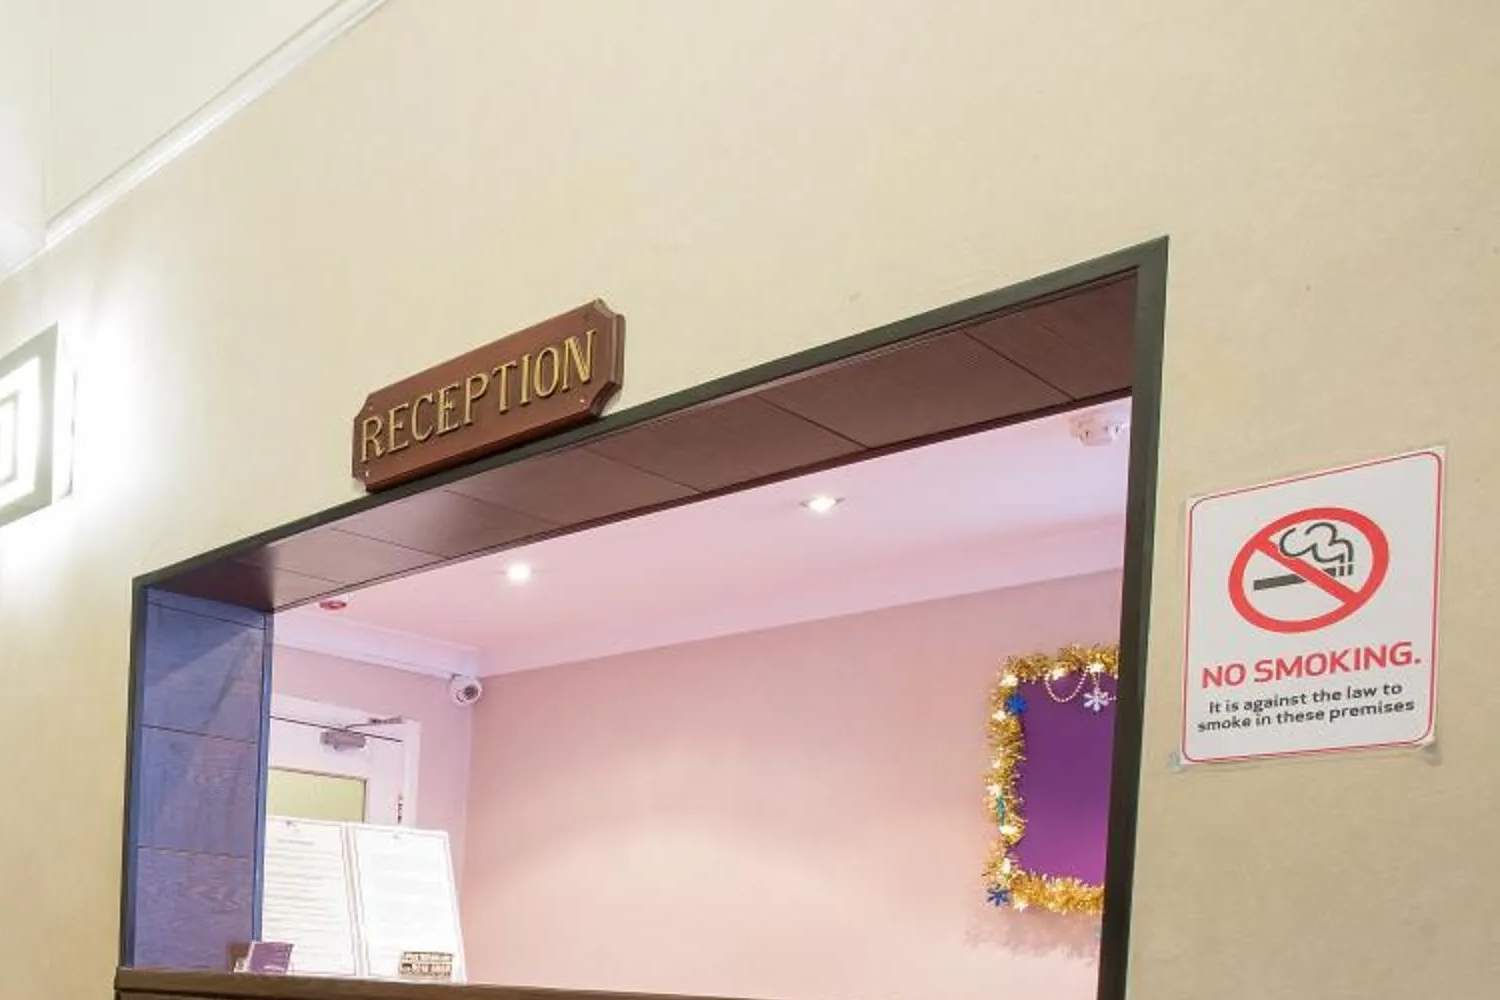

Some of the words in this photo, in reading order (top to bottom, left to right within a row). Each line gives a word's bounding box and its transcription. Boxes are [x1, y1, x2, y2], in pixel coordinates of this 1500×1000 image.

[359, 328, 598, 465] RECEPTION
[1202, 663, 1246, 689] NO
[1253, 641, 1422, 683] SMOKING.
[1197, 715, 1252, 733] smoke
[1255, 713, 1272, 728] in
[1275, 708, 1326, 724] these
[1329, 699, 1416, 722] premises
[1209, 700, 1223, 715] It
[1225, 698, 1240, 714] is
[1243, 692, 1308, 713] against
[1312, 687, 1342, 704] the
[1346, 684, 1378, 700] law
[1383, 682, 1403, 696] to
